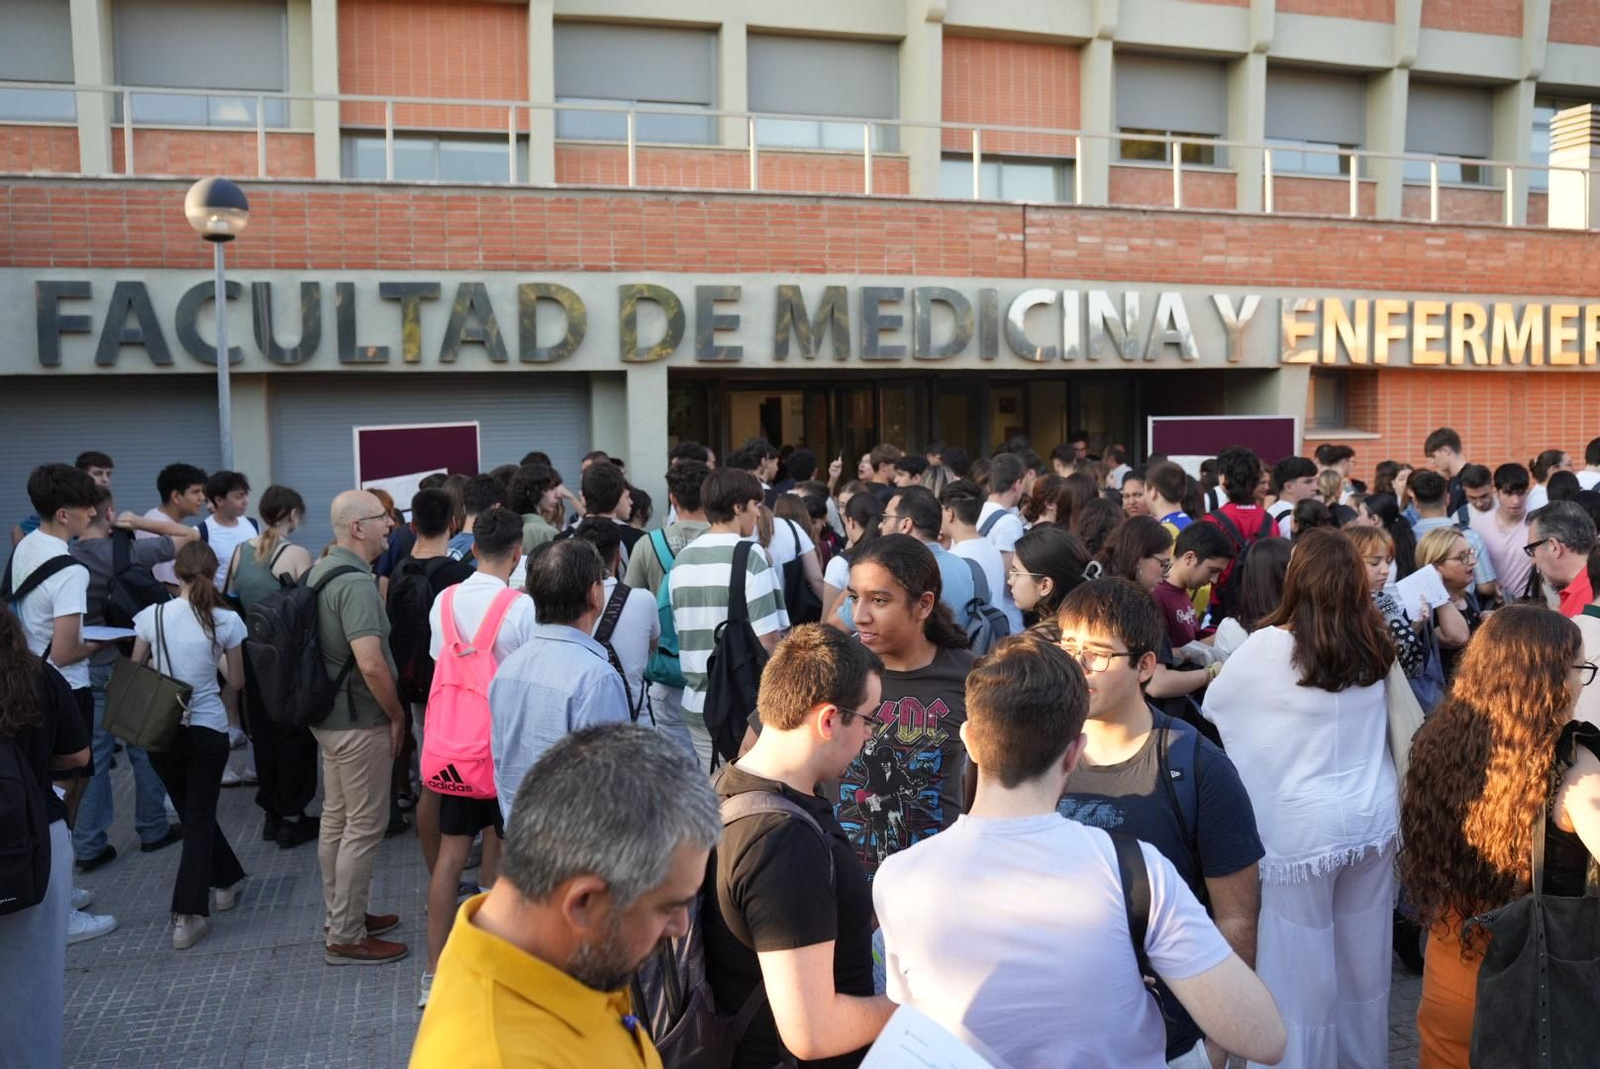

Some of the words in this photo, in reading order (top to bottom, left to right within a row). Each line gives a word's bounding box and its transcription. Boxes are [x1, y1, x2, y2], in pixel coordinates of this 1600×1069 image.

[36, 280, 588, 367] FACULTAD
[618, 284, 744, 363] DE
[774, 284, 1200, 364] MEDICINA
[1212, 293, 1262, 363] Y
[428, 780, 474, 793] adidas
